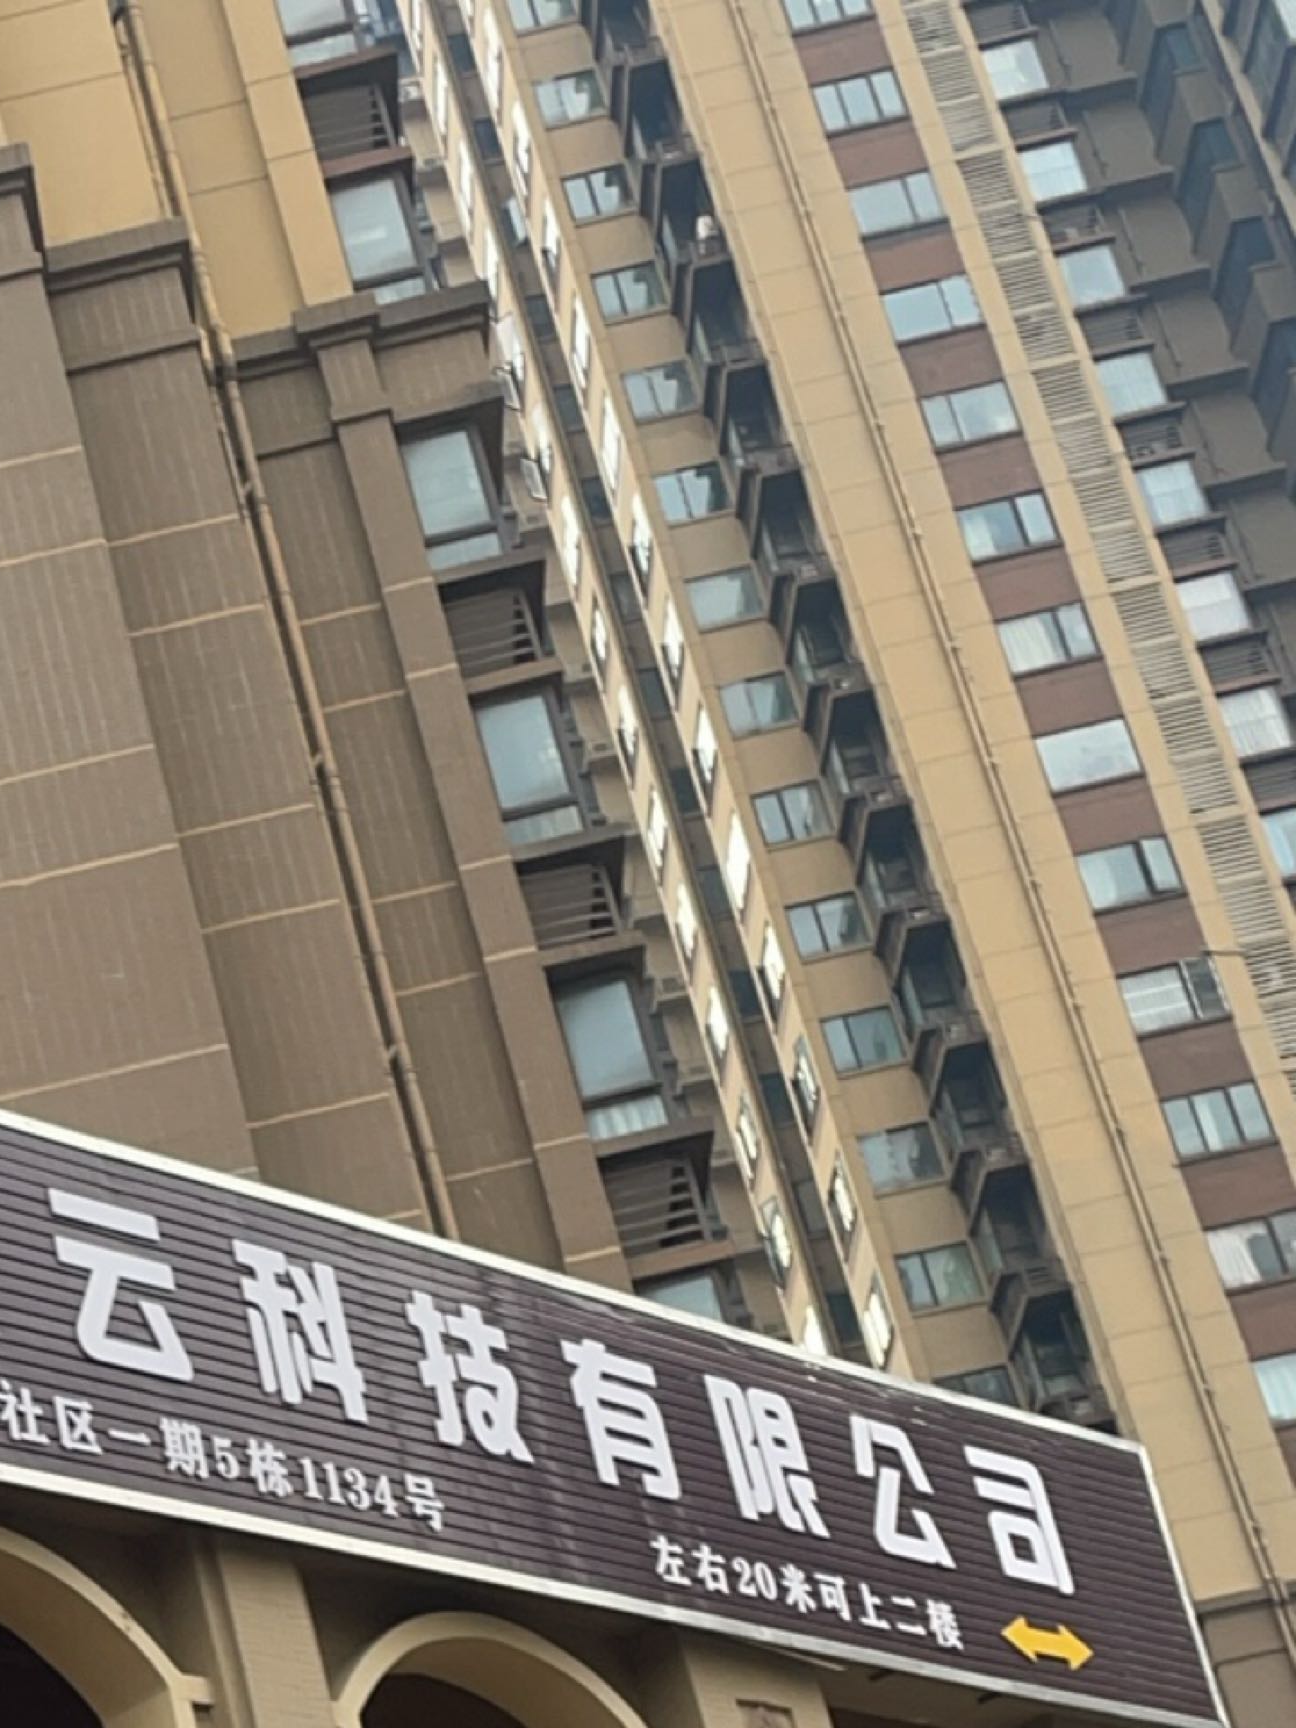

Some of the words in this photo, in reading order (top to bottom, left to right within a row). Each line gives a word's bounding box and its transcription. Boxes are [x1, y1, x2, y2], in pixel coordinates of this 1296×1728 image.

[650, 1535, 964, 1651] 左右20米可上二楼
